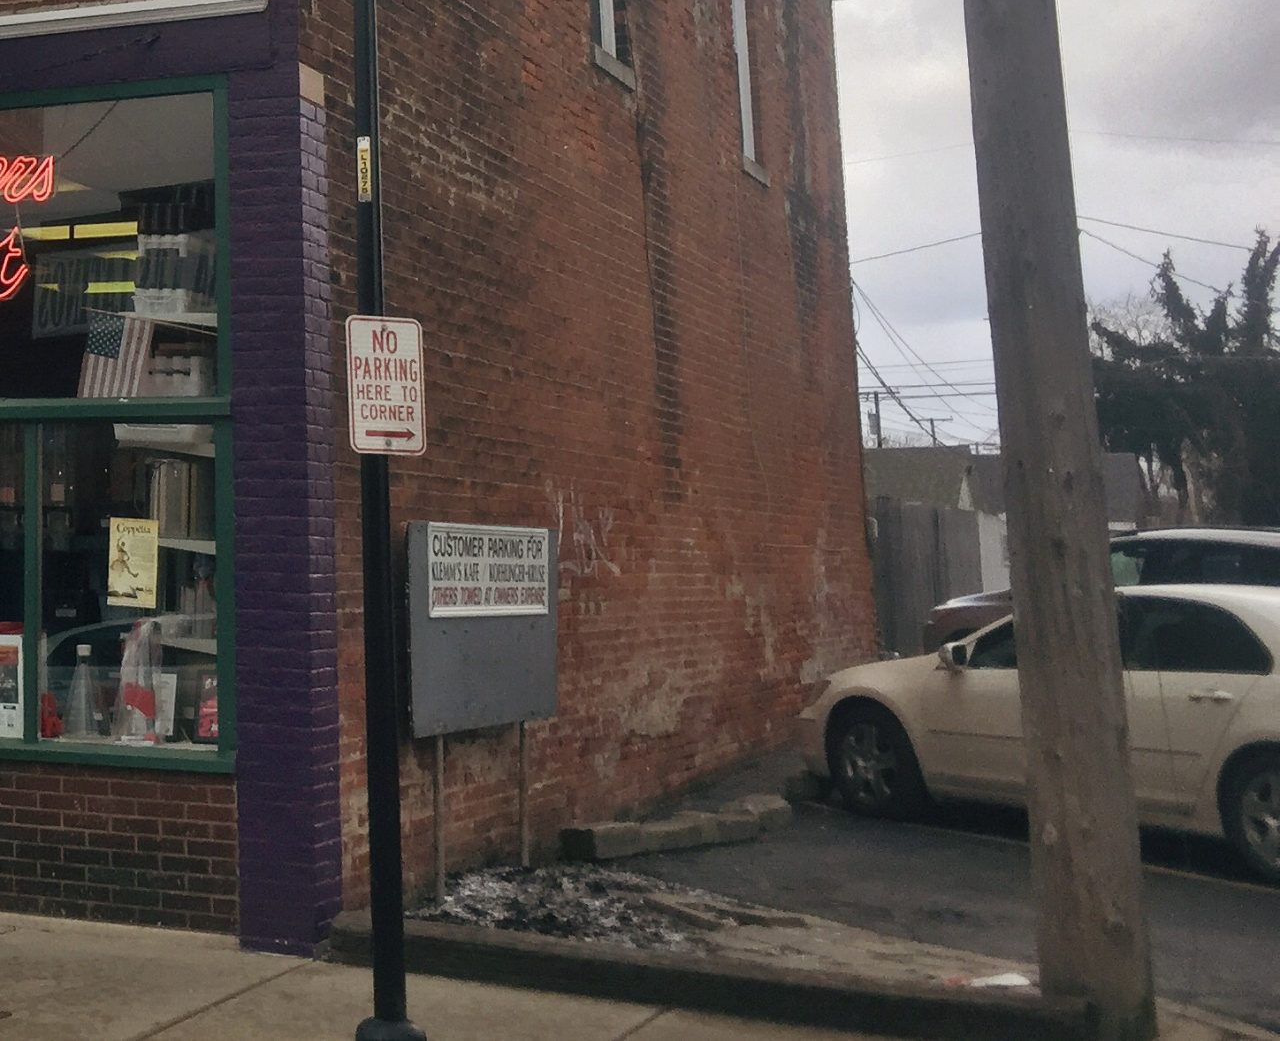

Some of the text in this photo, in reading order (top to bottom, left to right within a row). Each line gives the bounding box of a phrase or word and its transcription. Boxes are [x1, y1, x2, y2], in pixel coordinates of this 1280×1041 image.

[371, 328, 398, 355] NO
[354, 356, 419, 383] PARKING
[356, 383, 418, 403] HERE TO
[360, 405, 415, 422] CORNER
[432, 534, 543, 559] CUSTOMER PARKING FOR
